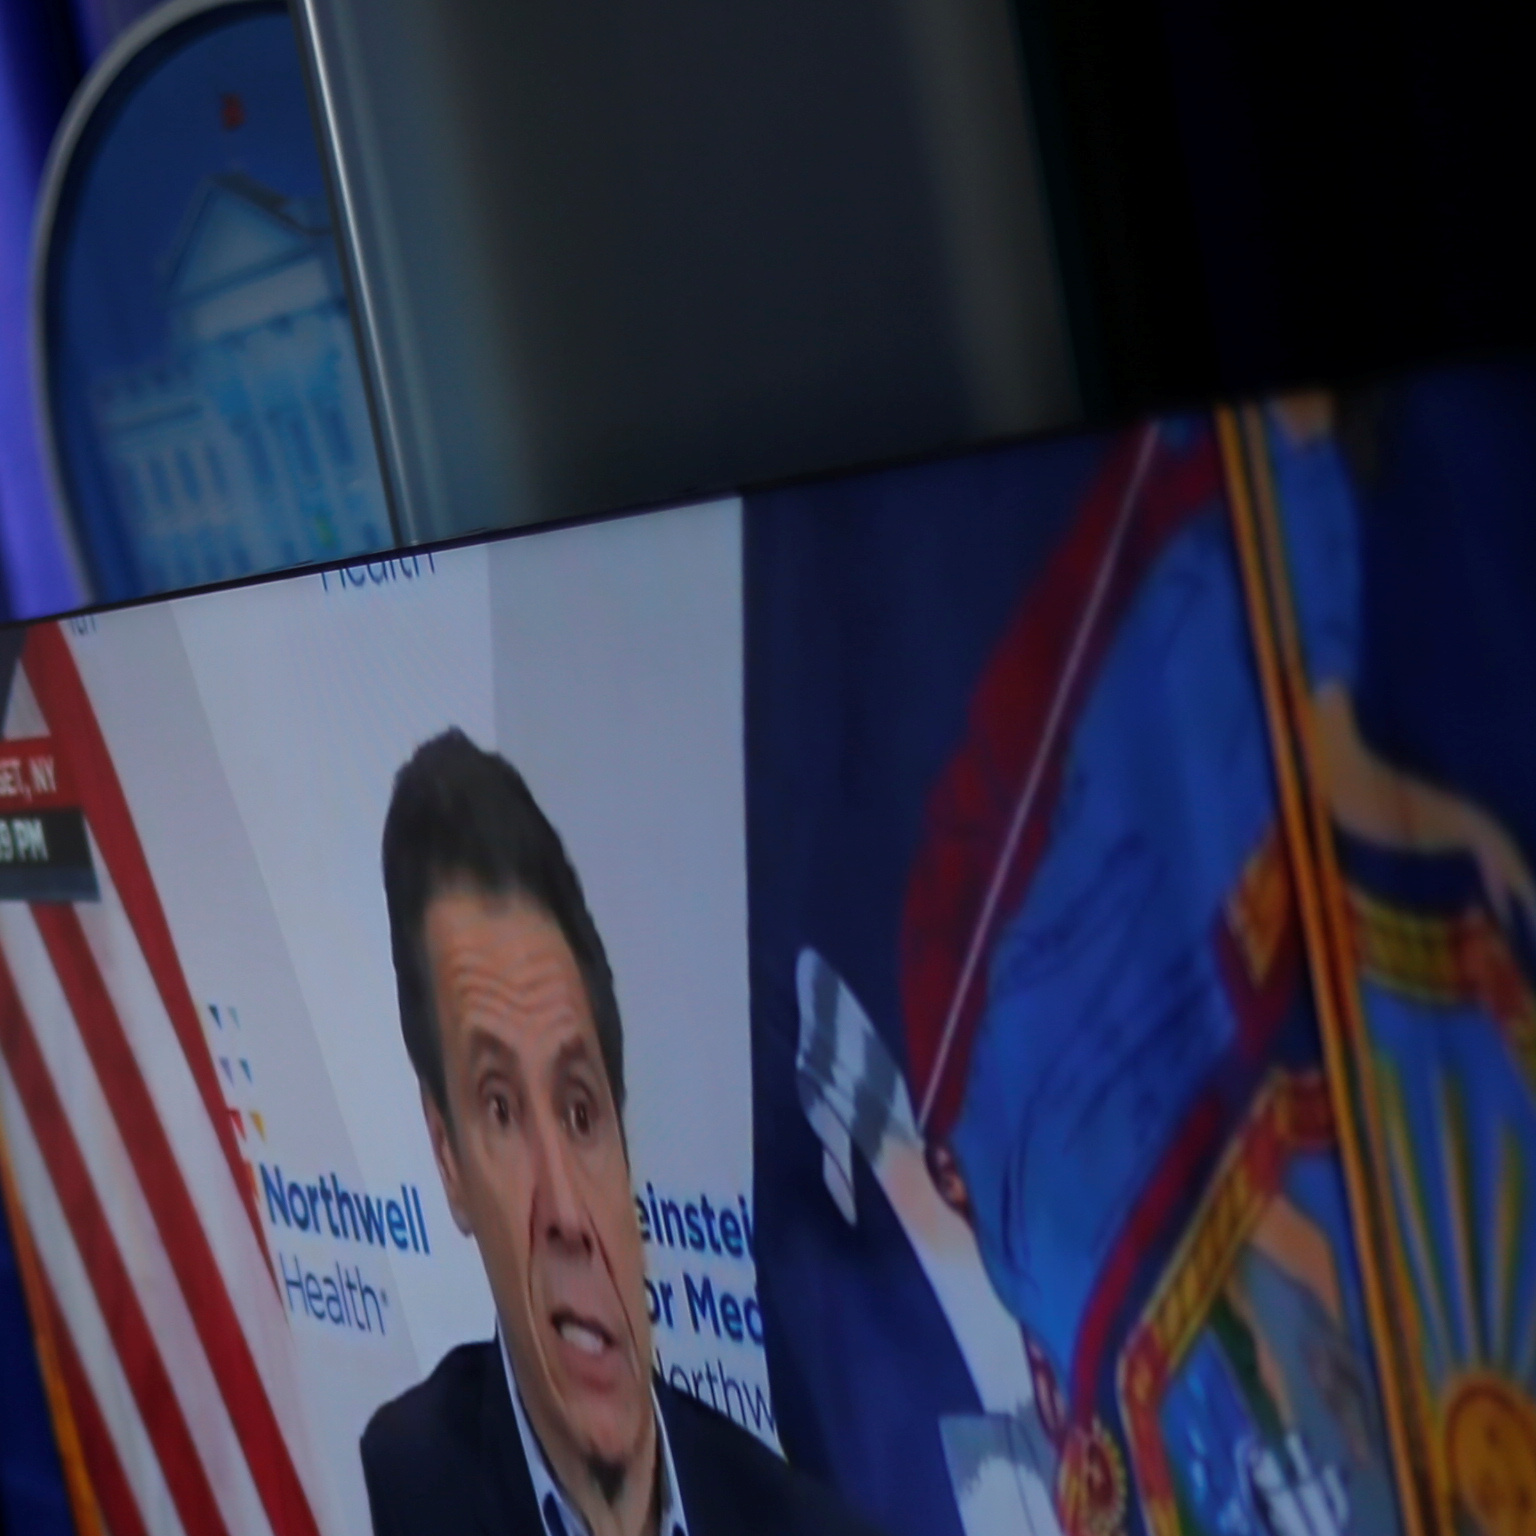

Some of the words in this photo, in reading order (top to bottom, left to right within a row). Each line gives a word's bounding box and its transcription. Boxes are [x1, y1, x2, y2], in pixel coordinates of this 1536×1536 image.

[29, 755, 57, 794] NY
[11, 817, 49, 862] PM
[259, 1162, 430, 1254] Northwell
[279, 1251, 386, 1336] Health
